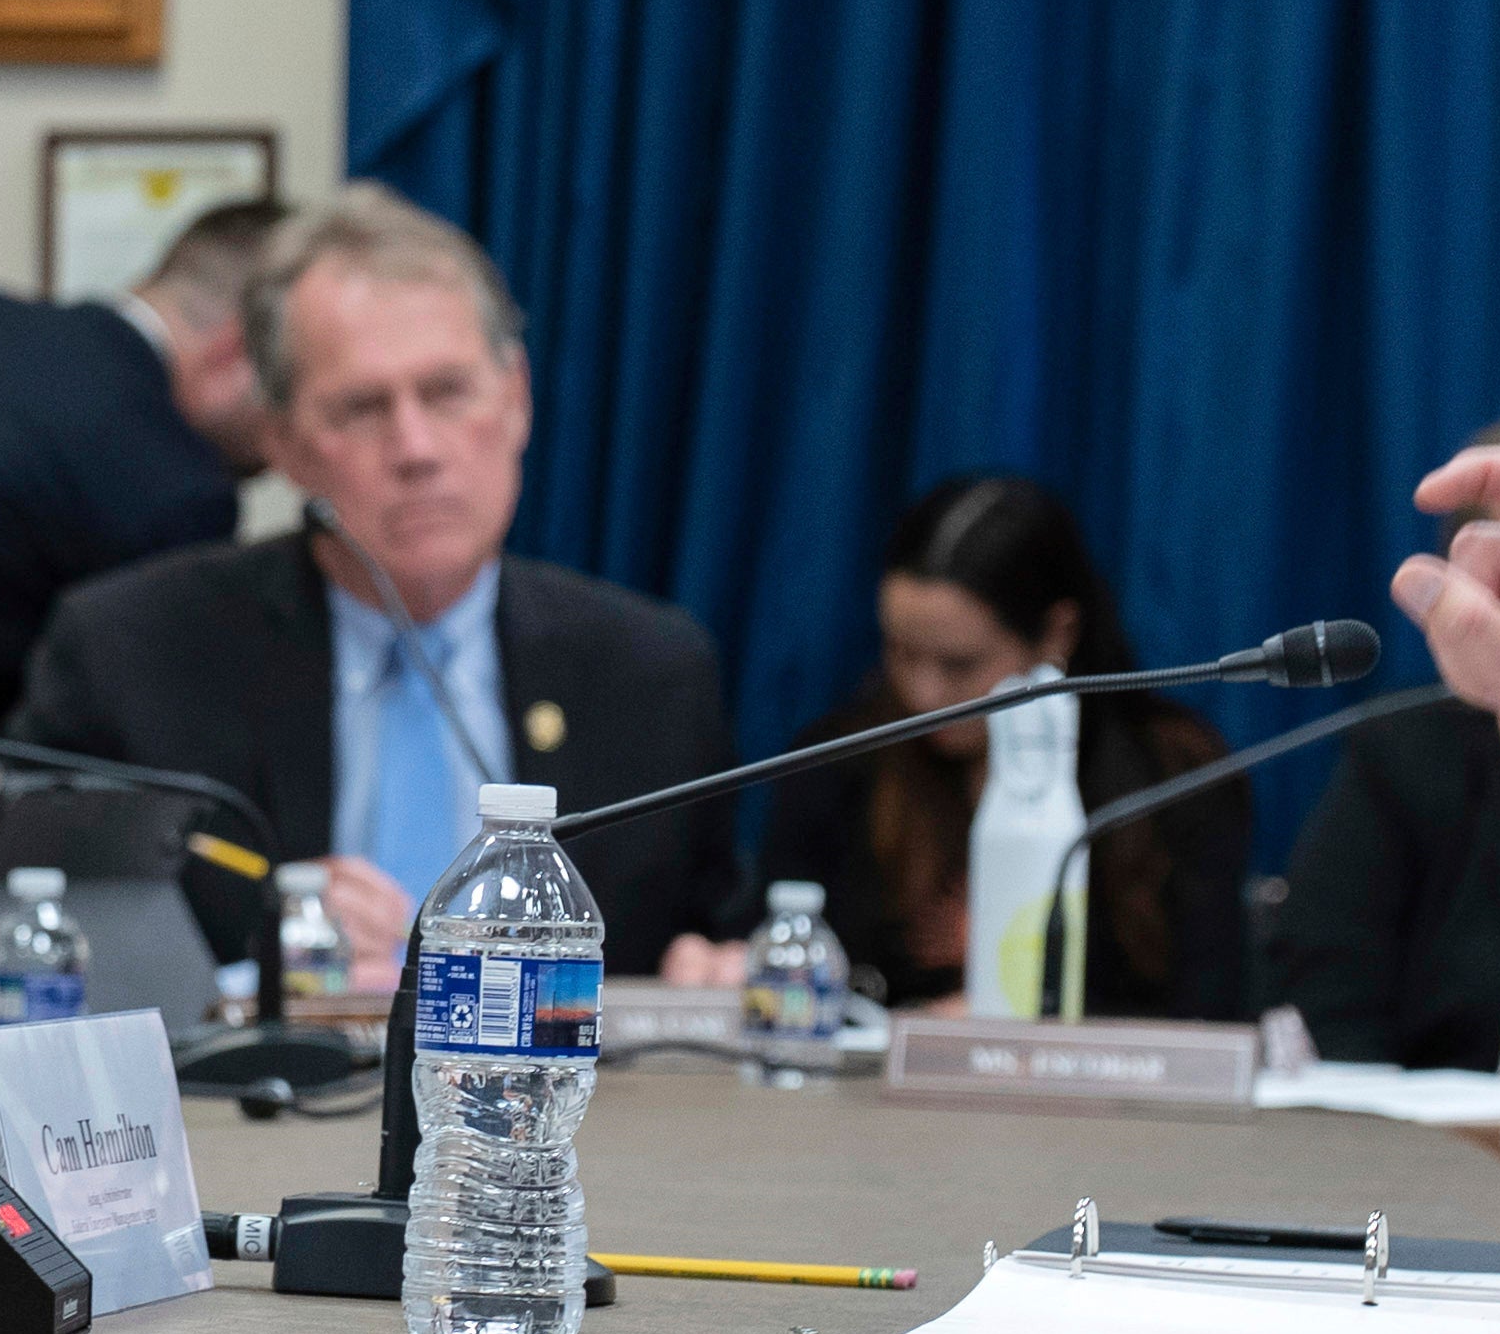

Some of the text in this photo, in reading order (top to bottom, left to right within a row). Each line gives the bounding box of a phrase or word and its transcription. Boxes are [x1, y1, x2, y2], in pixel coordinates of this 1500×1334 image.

[42, 1124, 82, 1175] Cam
[77, 1113, 157, 1169] Hamilton
[243, 1218, 262, 1255] MIC
